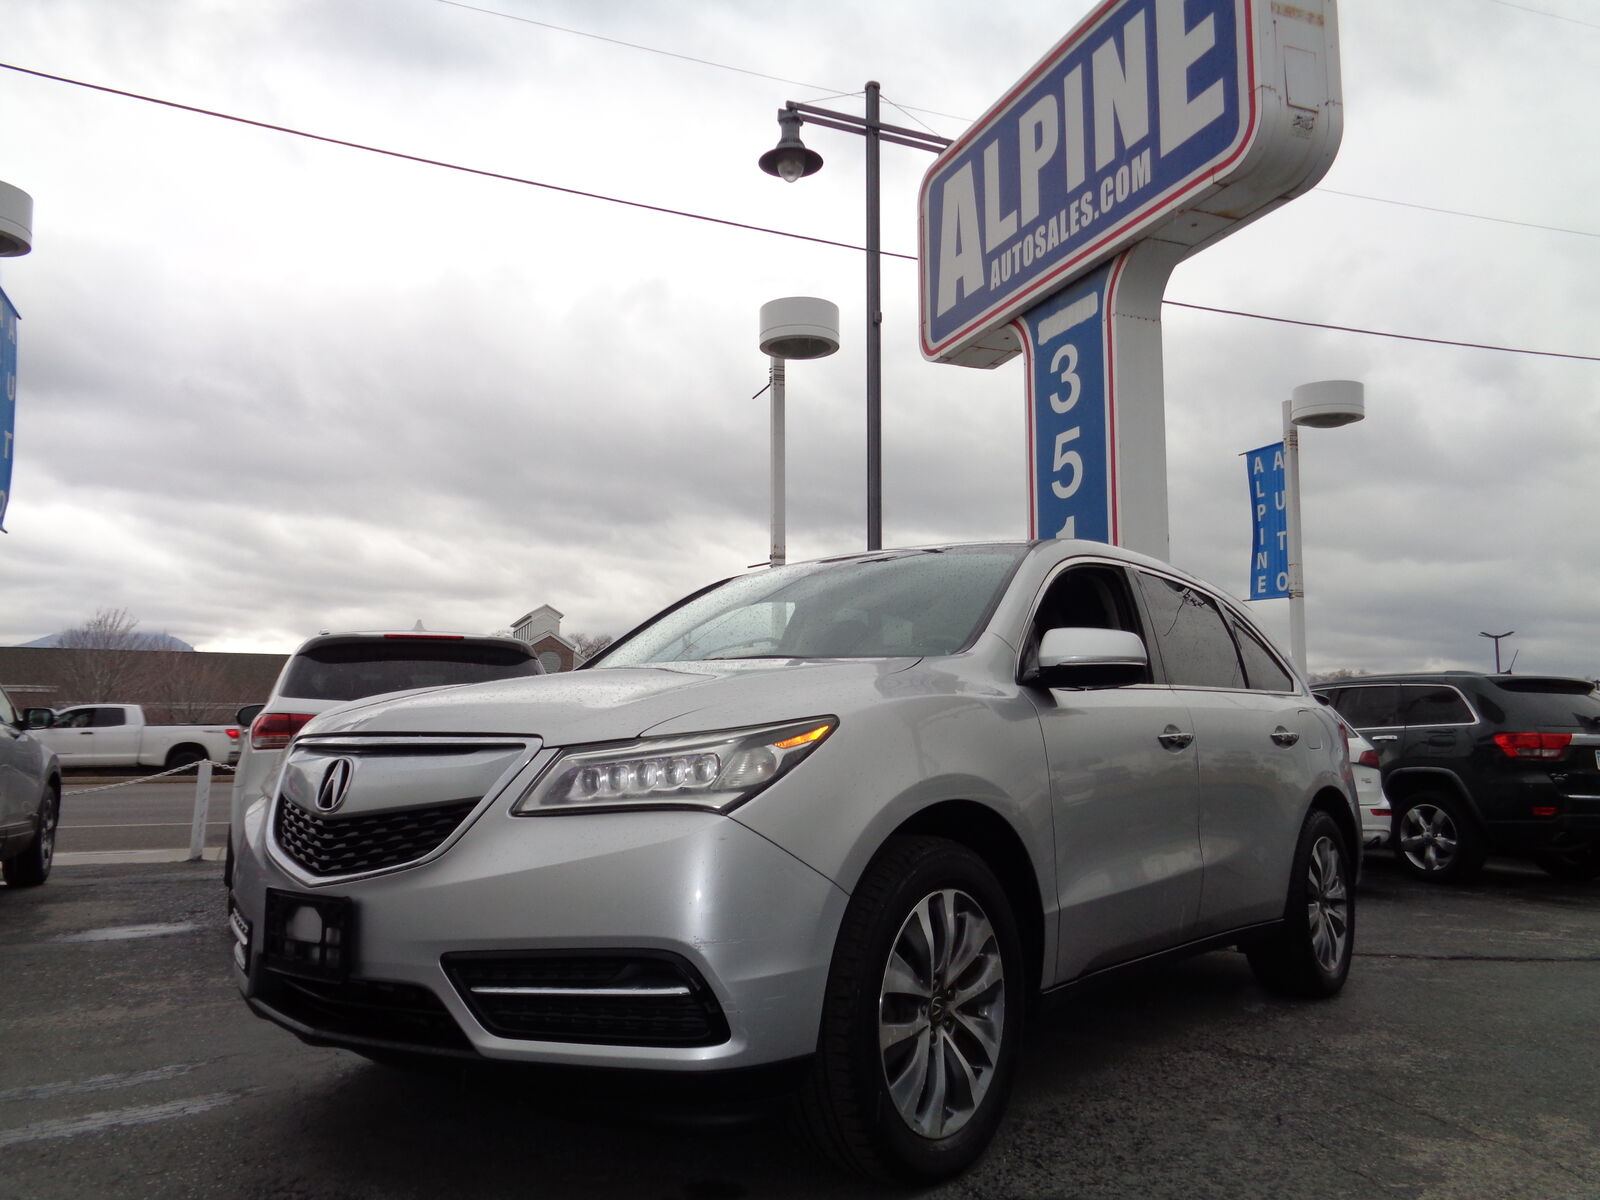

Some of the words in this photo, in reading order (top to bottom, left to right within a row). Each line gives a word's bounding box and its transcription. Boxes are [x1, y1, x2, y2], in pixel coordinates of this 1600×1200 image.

[937, 0, 1225, 318] ALPINE
[990, 147, 1151, 291] AUTOSALES.COM
[1254, 456, 1268, 594] ALPINE
[1273, 450, 1288, 592] AUTO
